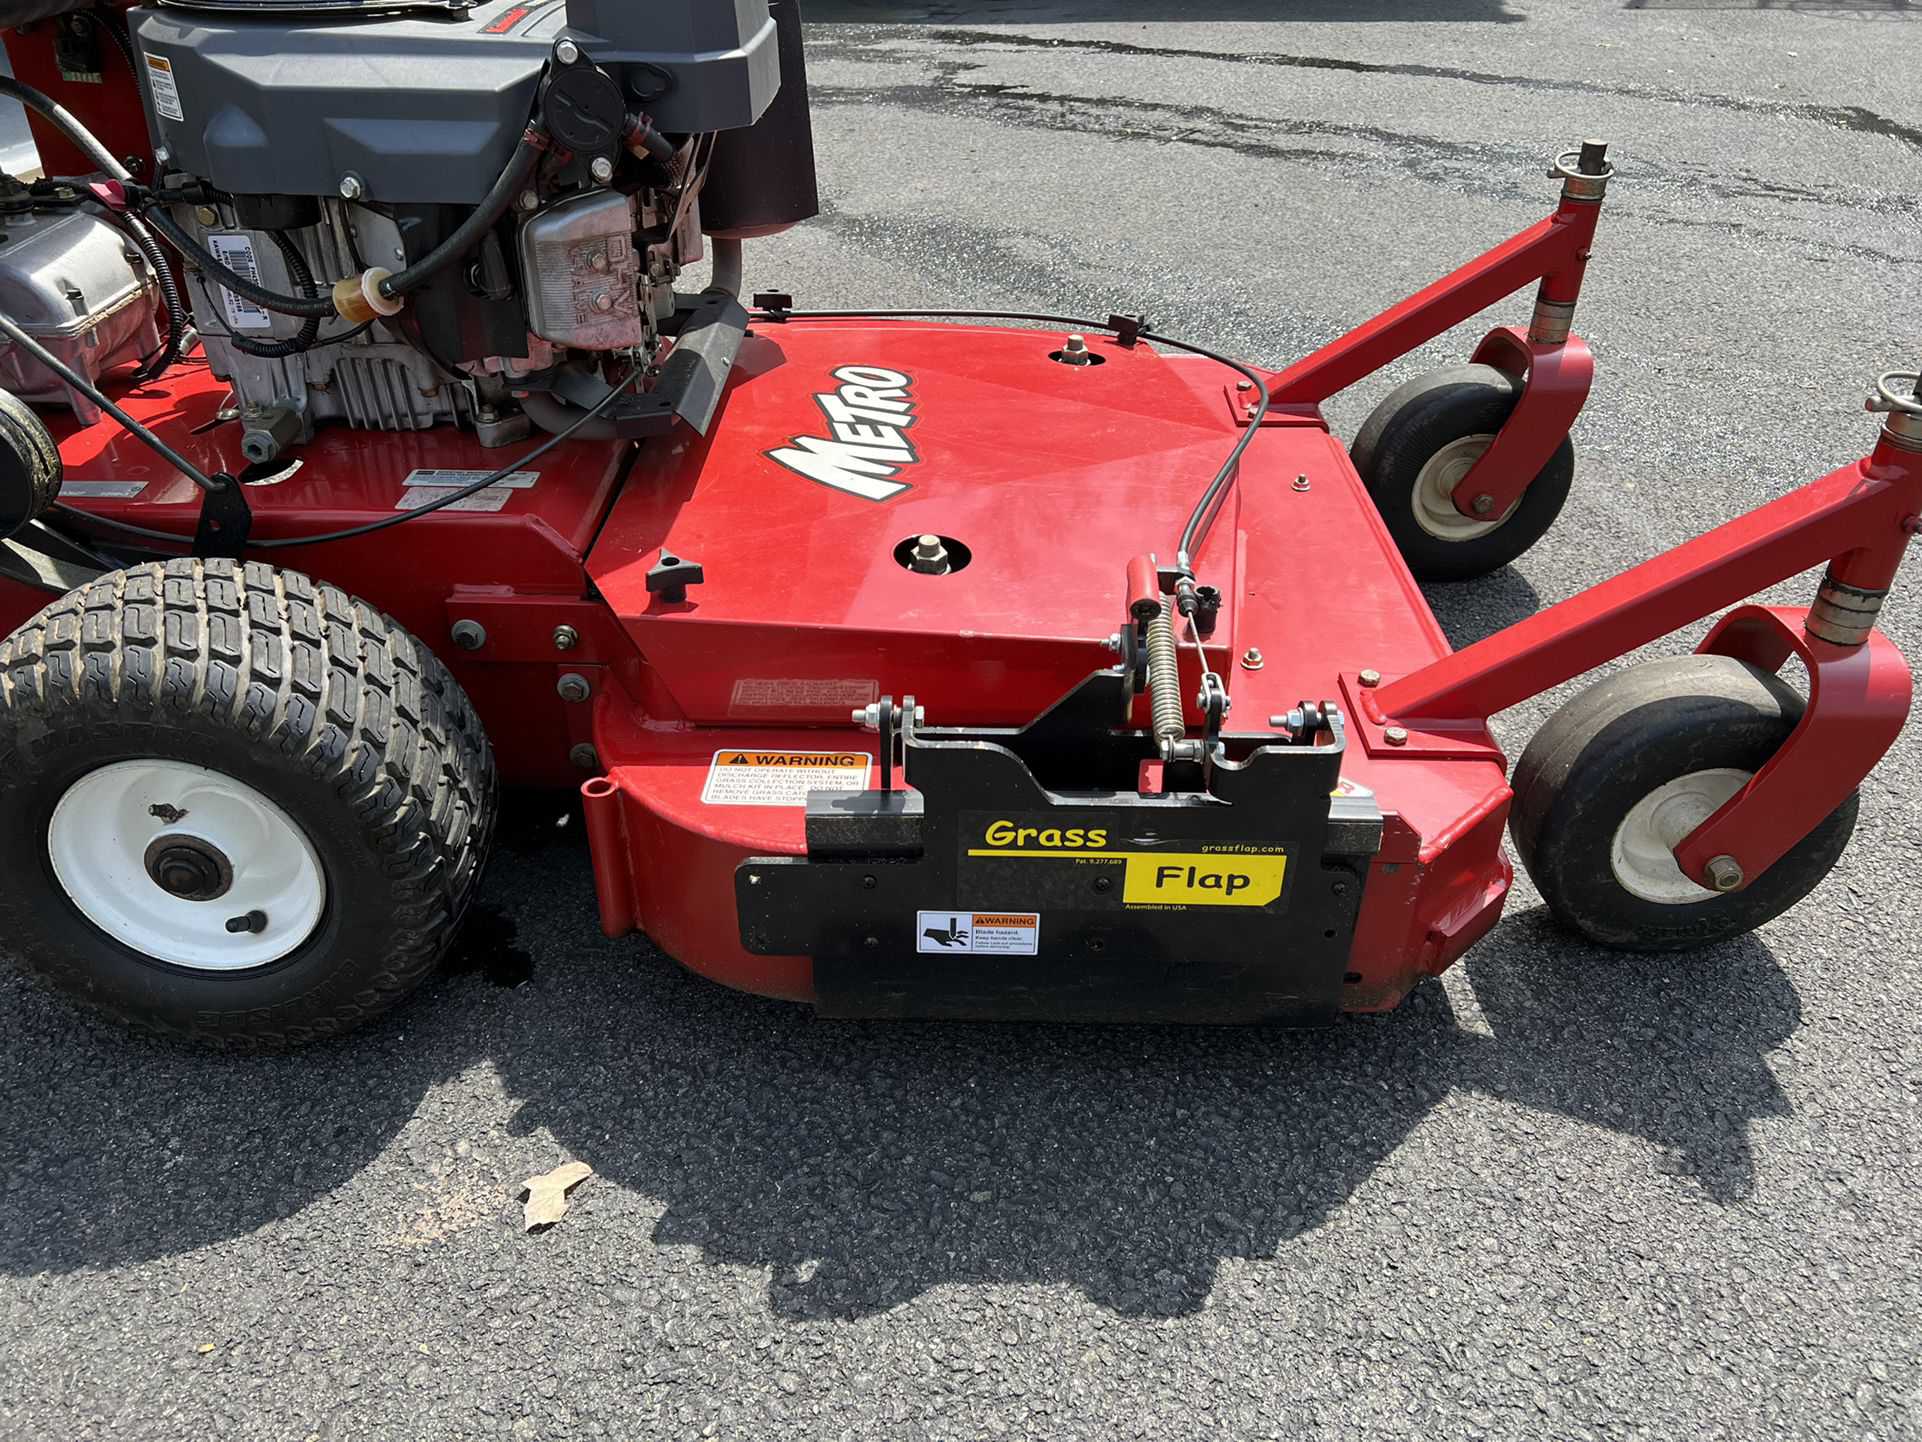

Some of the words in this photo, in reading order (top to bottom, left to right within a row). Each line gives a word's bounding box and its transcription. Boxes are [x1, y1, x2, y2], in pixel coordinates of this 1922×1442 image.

[607, 233, 635, 314] OHV
[762, 364, 920, 502] METRO
[756, 755, 856, 767] WARNING
[985, 820, 1108, 848] Grass
[1201, 843, 1284, 854] grassflap.com
[1155, 866, 1251, 896] Flap
[985, 917, 1034, 926] WARNING
